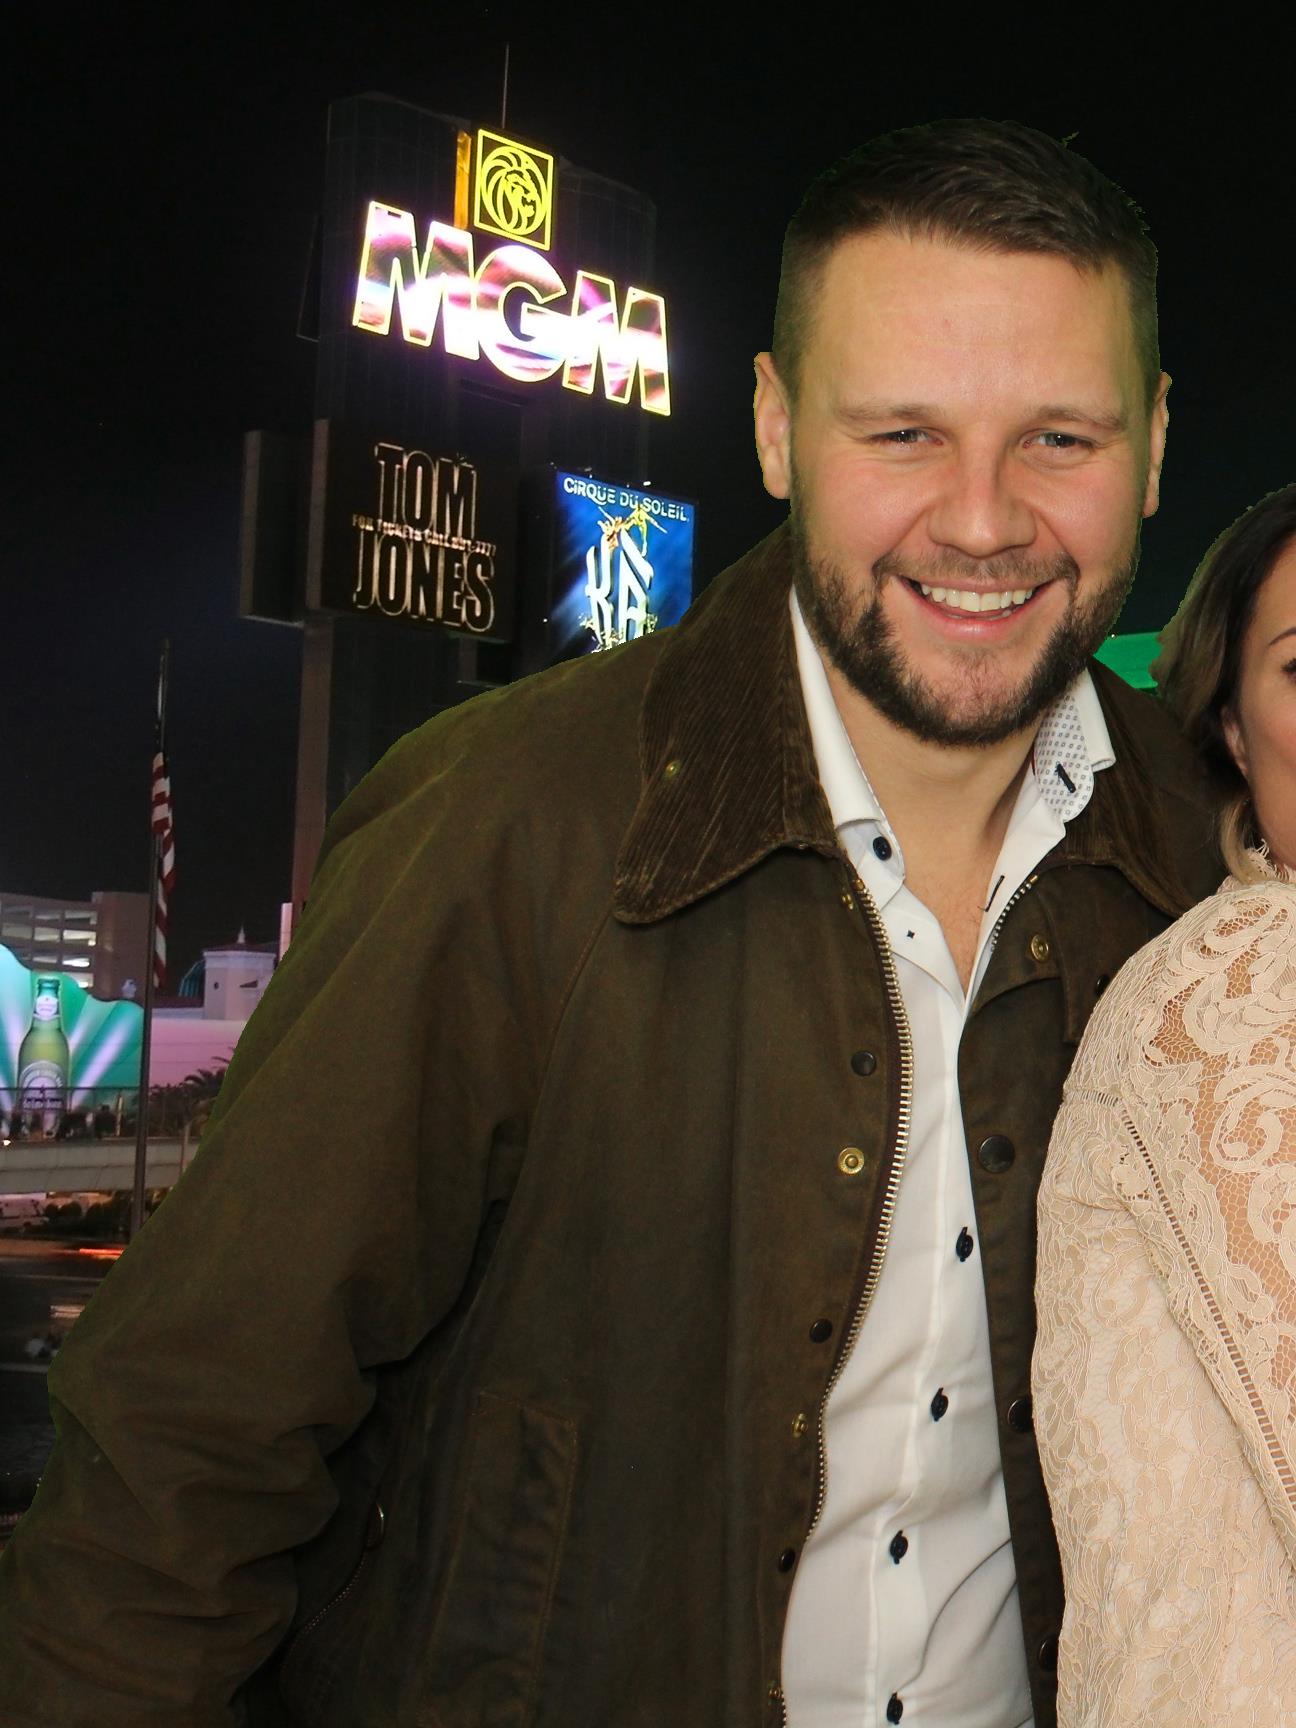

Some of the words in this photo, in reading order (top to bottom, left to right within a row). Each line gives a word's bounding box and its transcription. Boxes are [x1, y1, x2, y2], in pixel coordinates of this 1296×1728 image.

[352, 200, 671, 416] MGM
[374, 441, 477, 540] TOM
[563, 477, 616, 506] CIRQUE
[619, 491, 639, 509] DU
[641, 497, 688, 521] SOLEIL
[352, 528, 495, 632] JONES
